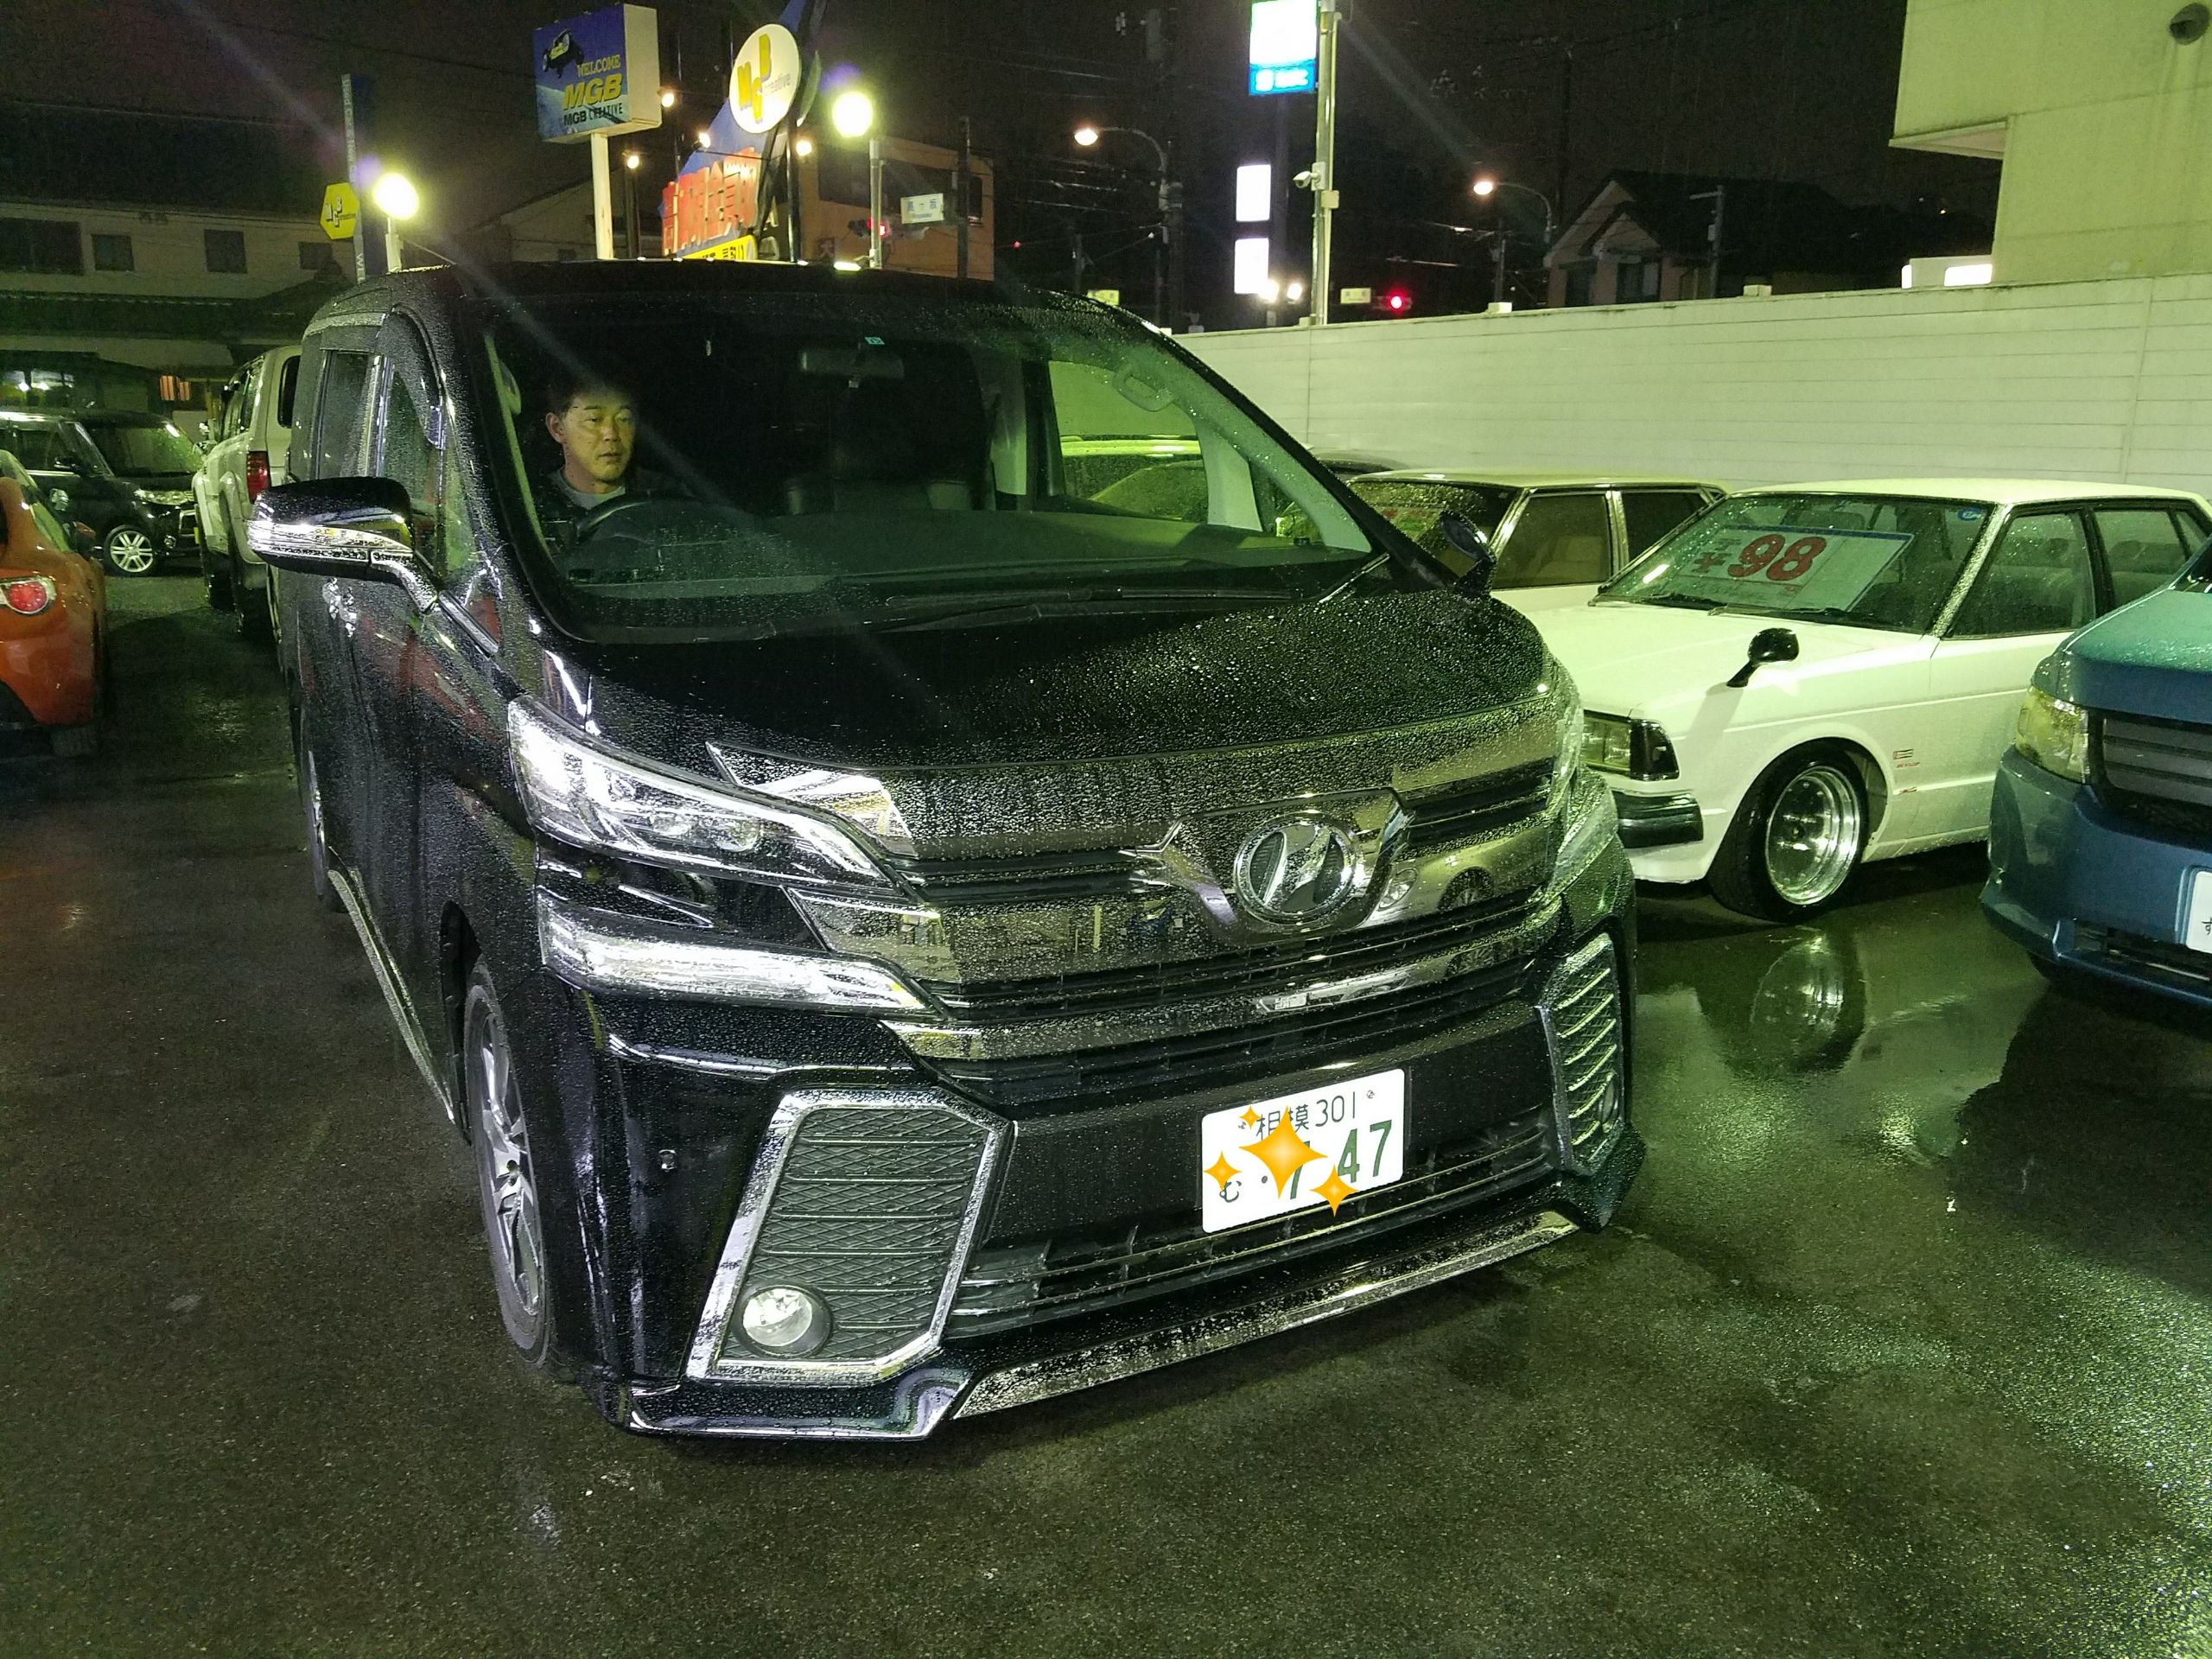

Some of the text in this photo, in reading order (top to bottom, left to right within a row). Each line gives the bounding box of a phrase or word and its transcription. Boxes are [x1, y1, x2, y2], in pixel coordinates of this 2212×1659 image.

[577, 54, 620, 77] WELCOME
[563, 73, 622, 111] MGB
[564, 111, 587, 125] MGB
